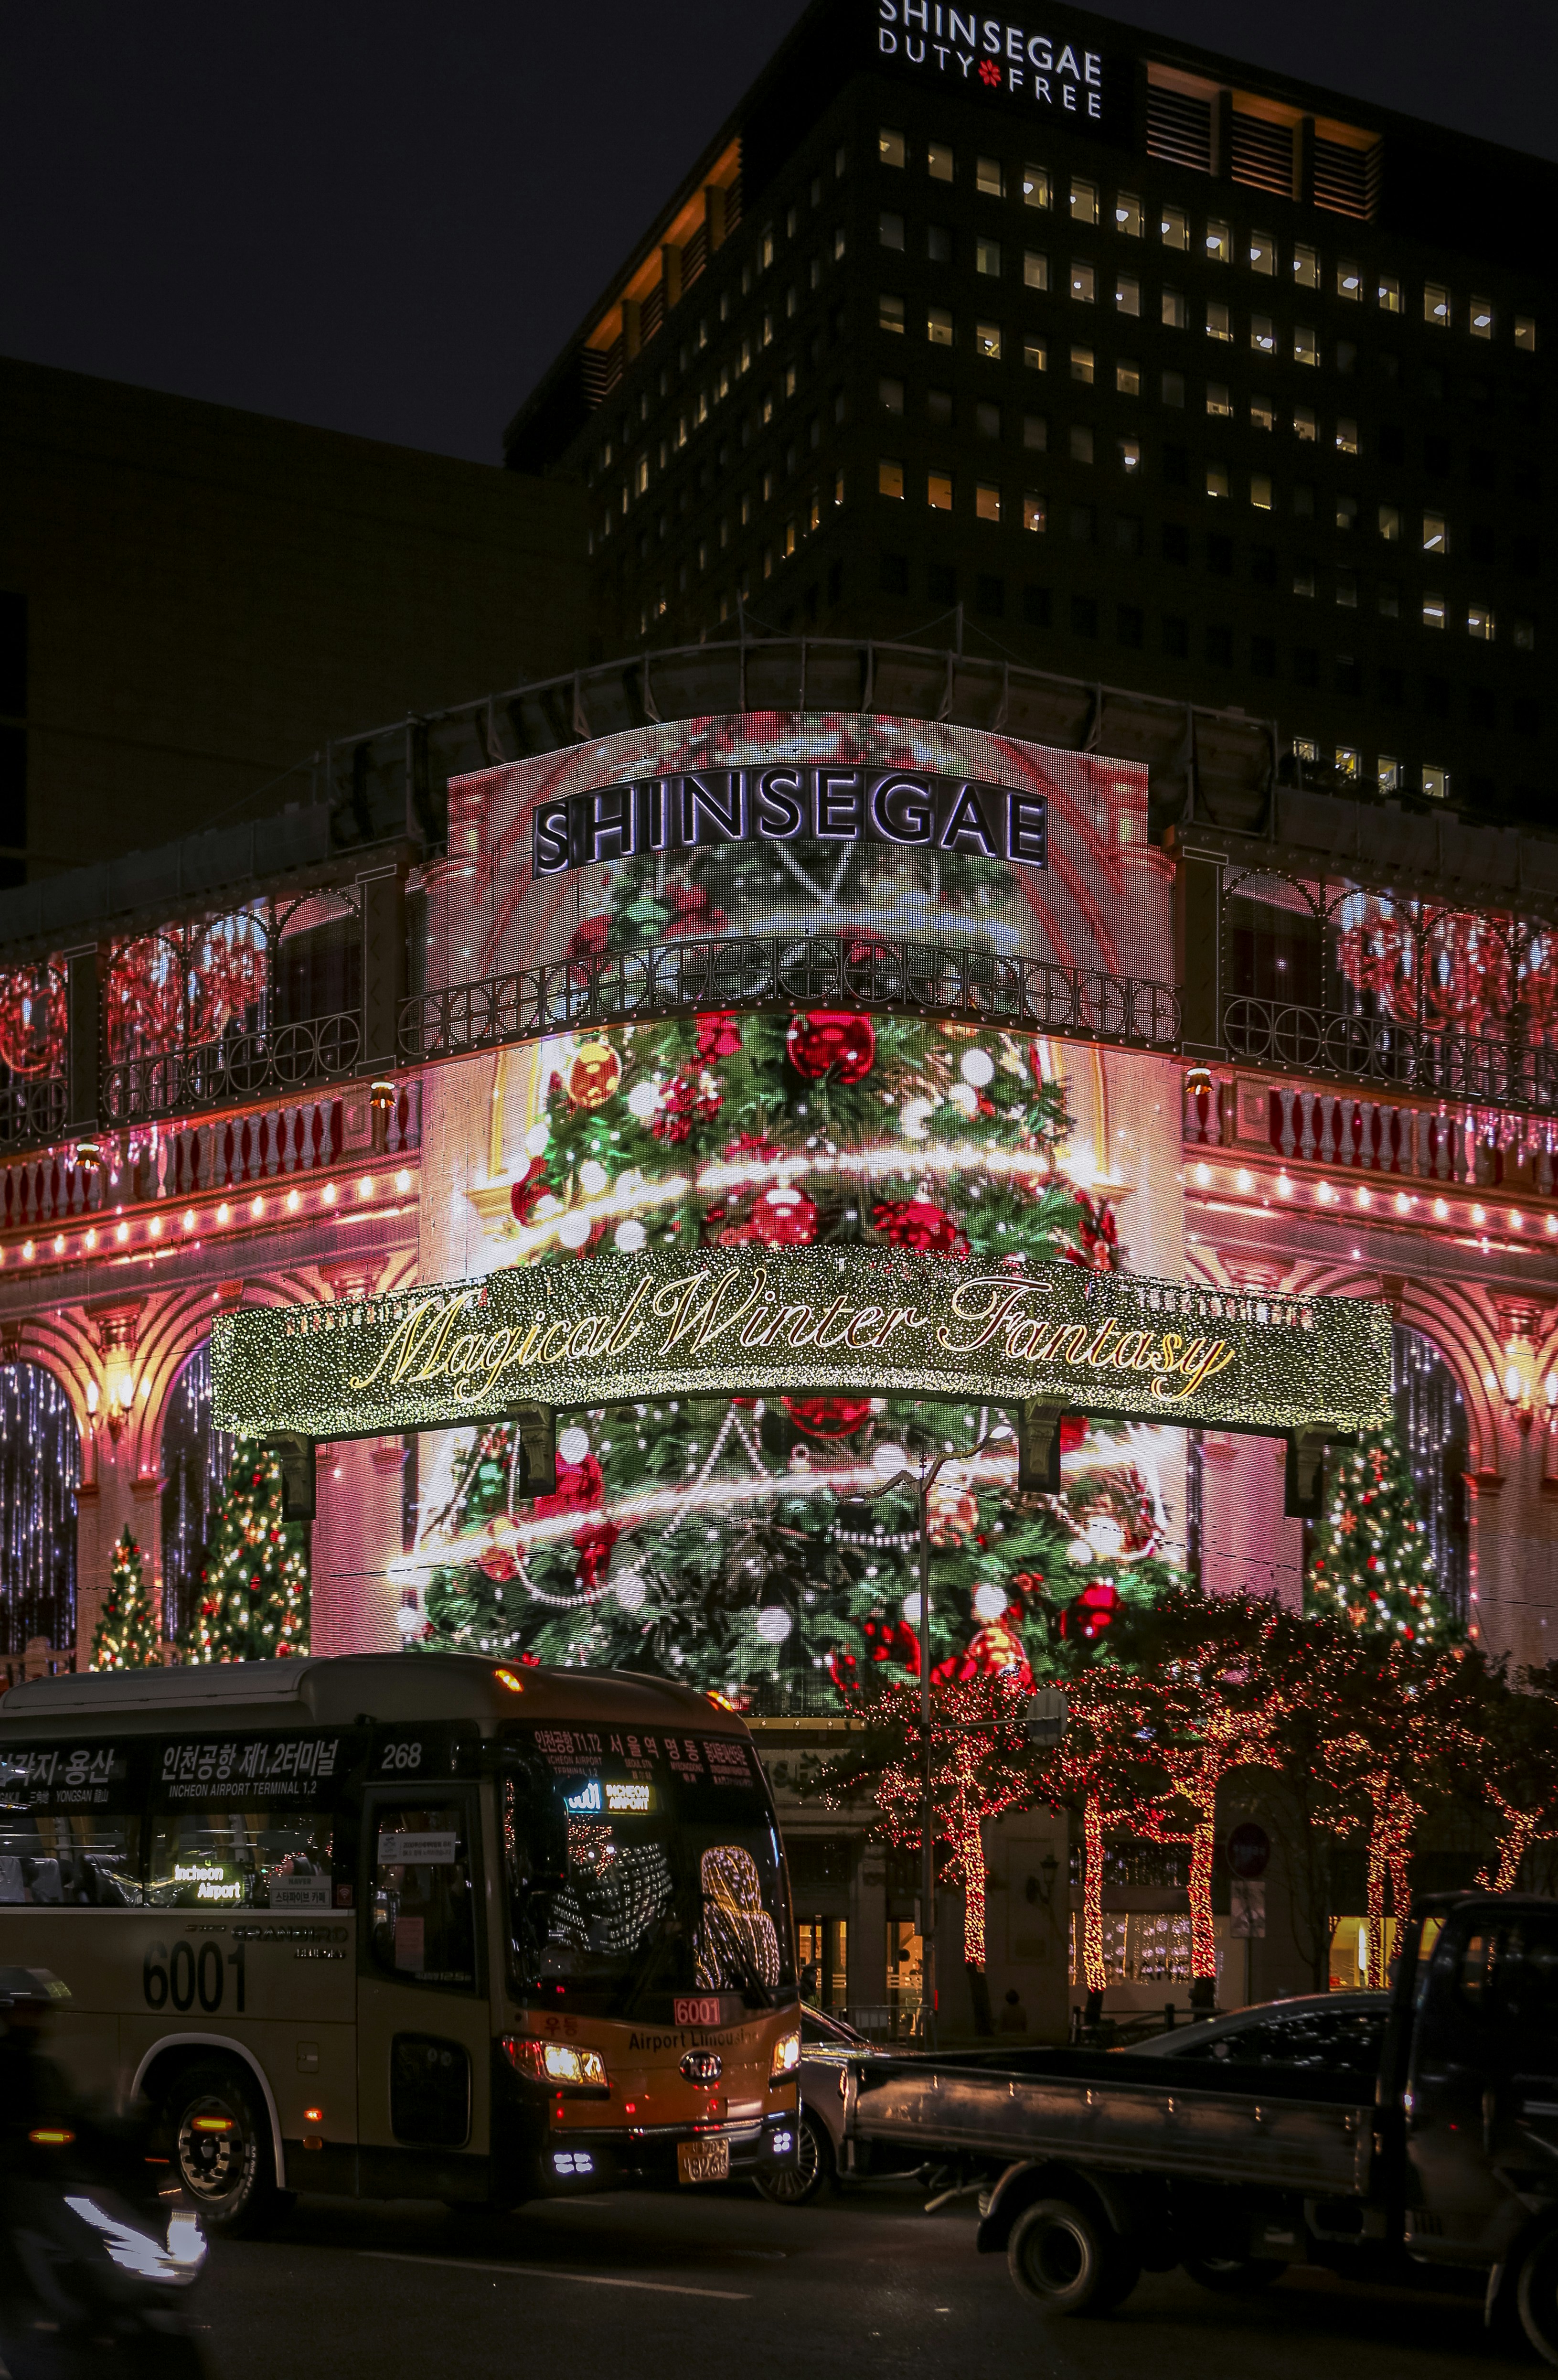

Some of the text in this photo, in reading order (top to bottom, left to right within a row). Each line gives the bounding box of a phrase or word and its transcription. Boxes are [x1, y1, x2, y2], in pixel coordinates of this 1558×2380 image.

[879, 0, 1100, 87] SHINSEGAE
[879, 27, 1100, 118] DUTY FREE
[536, 768, 1044, 873] SHINSEGAE
[350, 1268, 1236, 1403] Magical Winter Fantasy
[534, 1730, 575, 1754] 인천공항
[161, 1739, 339, 1781] 인천공항 제1,2터미널
[381, 1742, 422, 1769] 268
[547, 1755, 602, 1766] NCHEON AIRPORT
[55, 1790, 93, 1803] YONGSAN
[169, 1781, 317, 1798] INCHEON AIRPORT TERMINAL 1,2
[606, 1784, 650, 1798] INCHEON
[608, 1796, 650, 1810] AIRPORT
[174, 1865, 224, 1881] Incheon
[197, 1882, 241, 1900] Airport
[232, 1925, 349, 1943] GRANBIRD
[144, 1940, 245, 2013] 6001
[1104, 1960, 1190, 1981] CHANE
[677, 2000, 717, 2024] 6001
[544, 2016, 578, 2037] 우등
[629, 2032, 686, 2052] Airport
[689, 2056, 718, 2077] KIA
